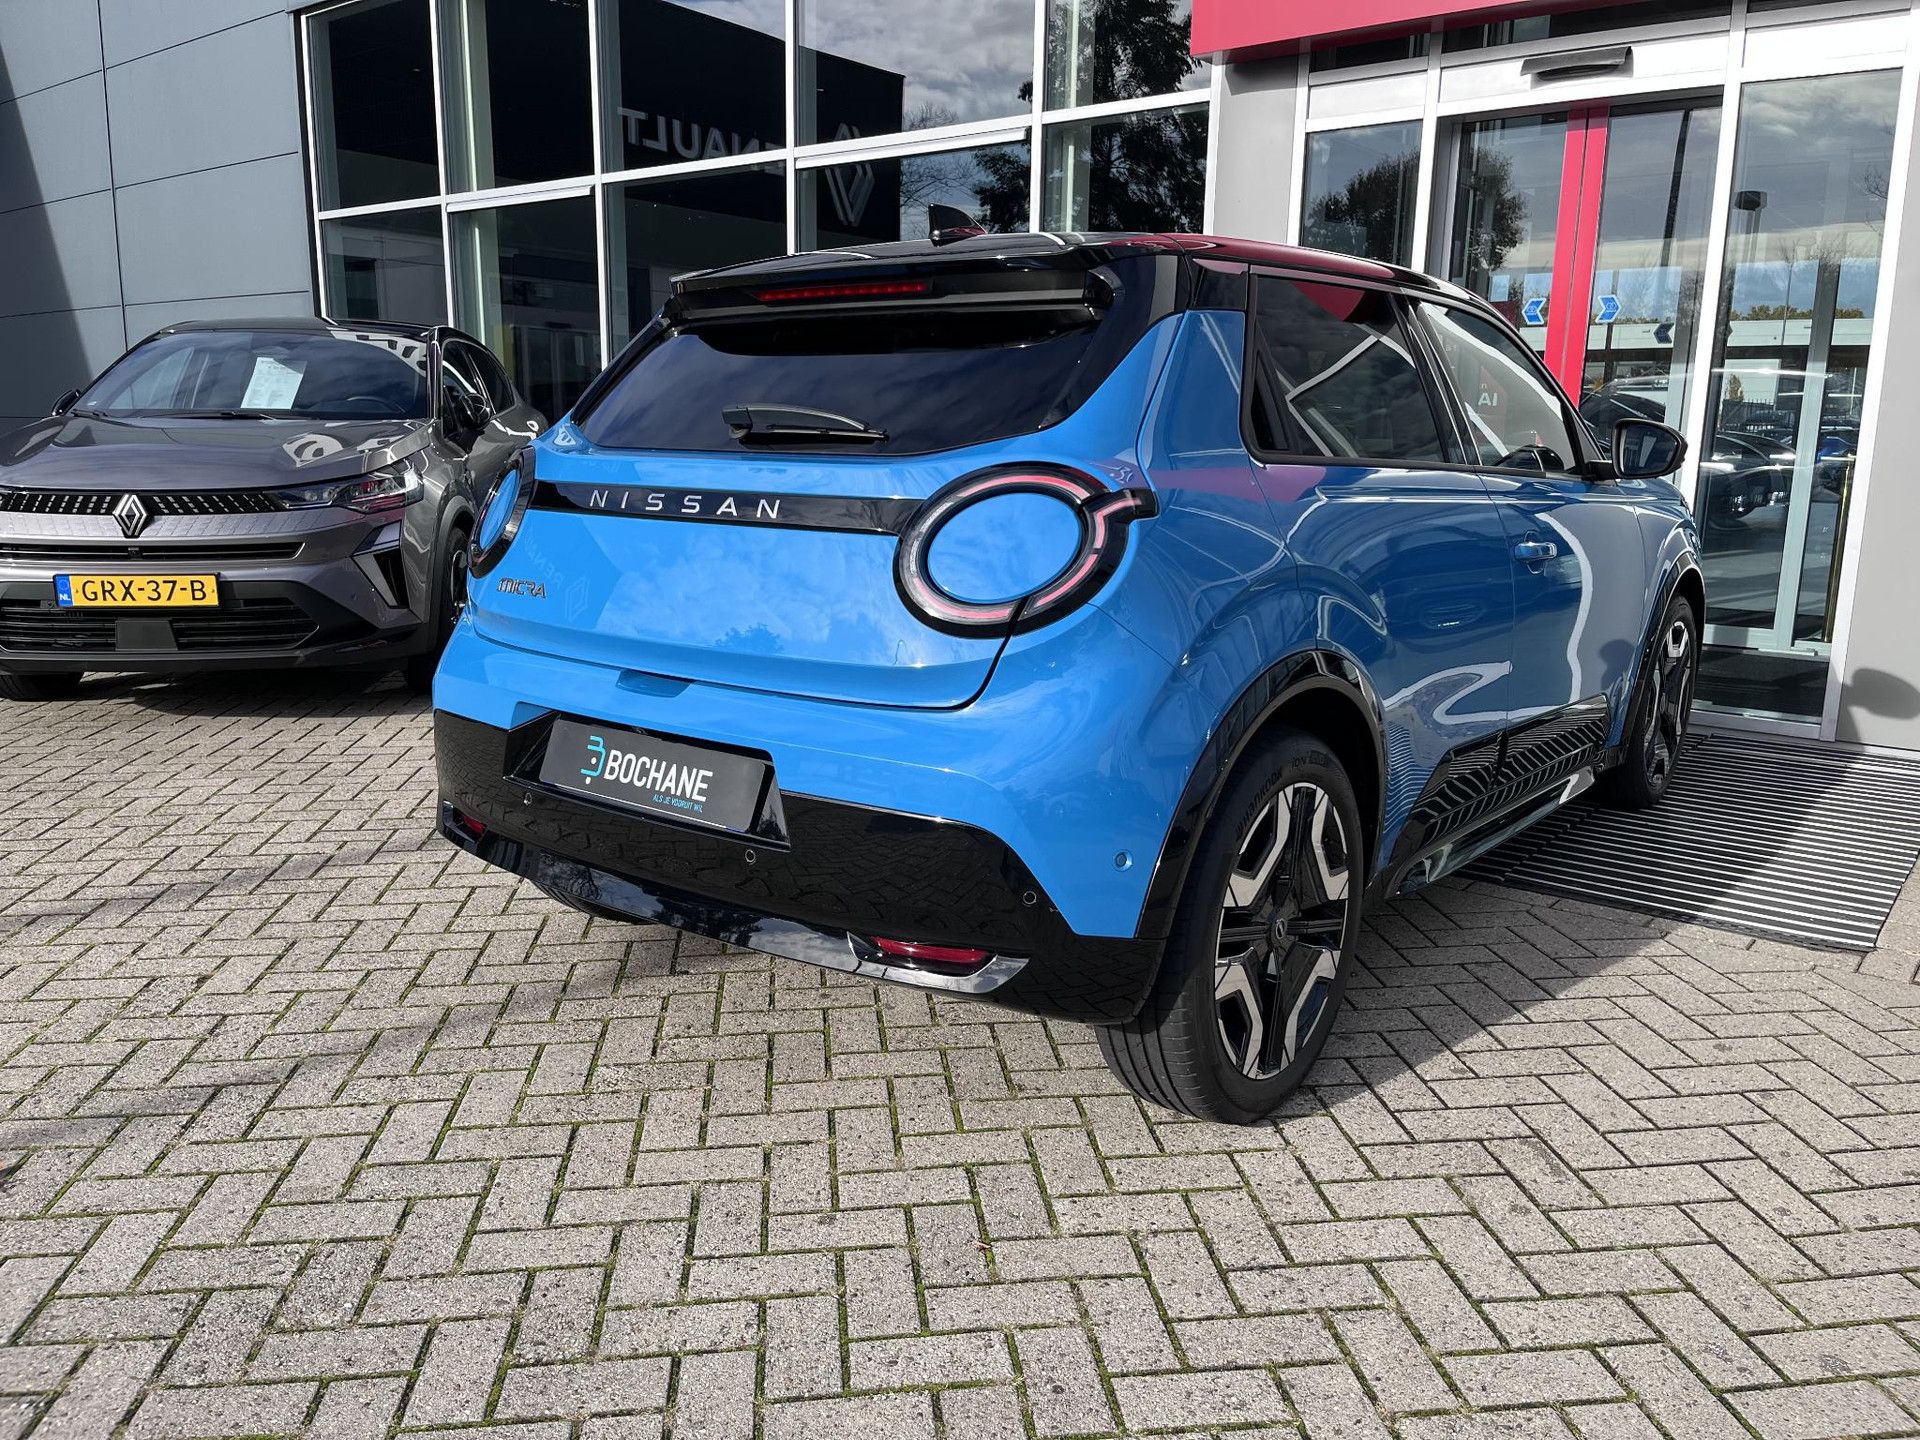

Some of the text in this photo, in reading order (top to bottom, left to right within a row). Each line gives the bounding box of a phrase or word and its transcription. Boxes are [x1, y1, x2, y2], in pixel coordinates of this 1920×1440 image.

[589, 489, 780, 519] NISSAN
[59, 593, 71, 601] NL
[82, 579, 207, 602] GRX-37-B
[497, 577, 546, 599] MICRA
[603, 750, 713, 802] BOCHANE
